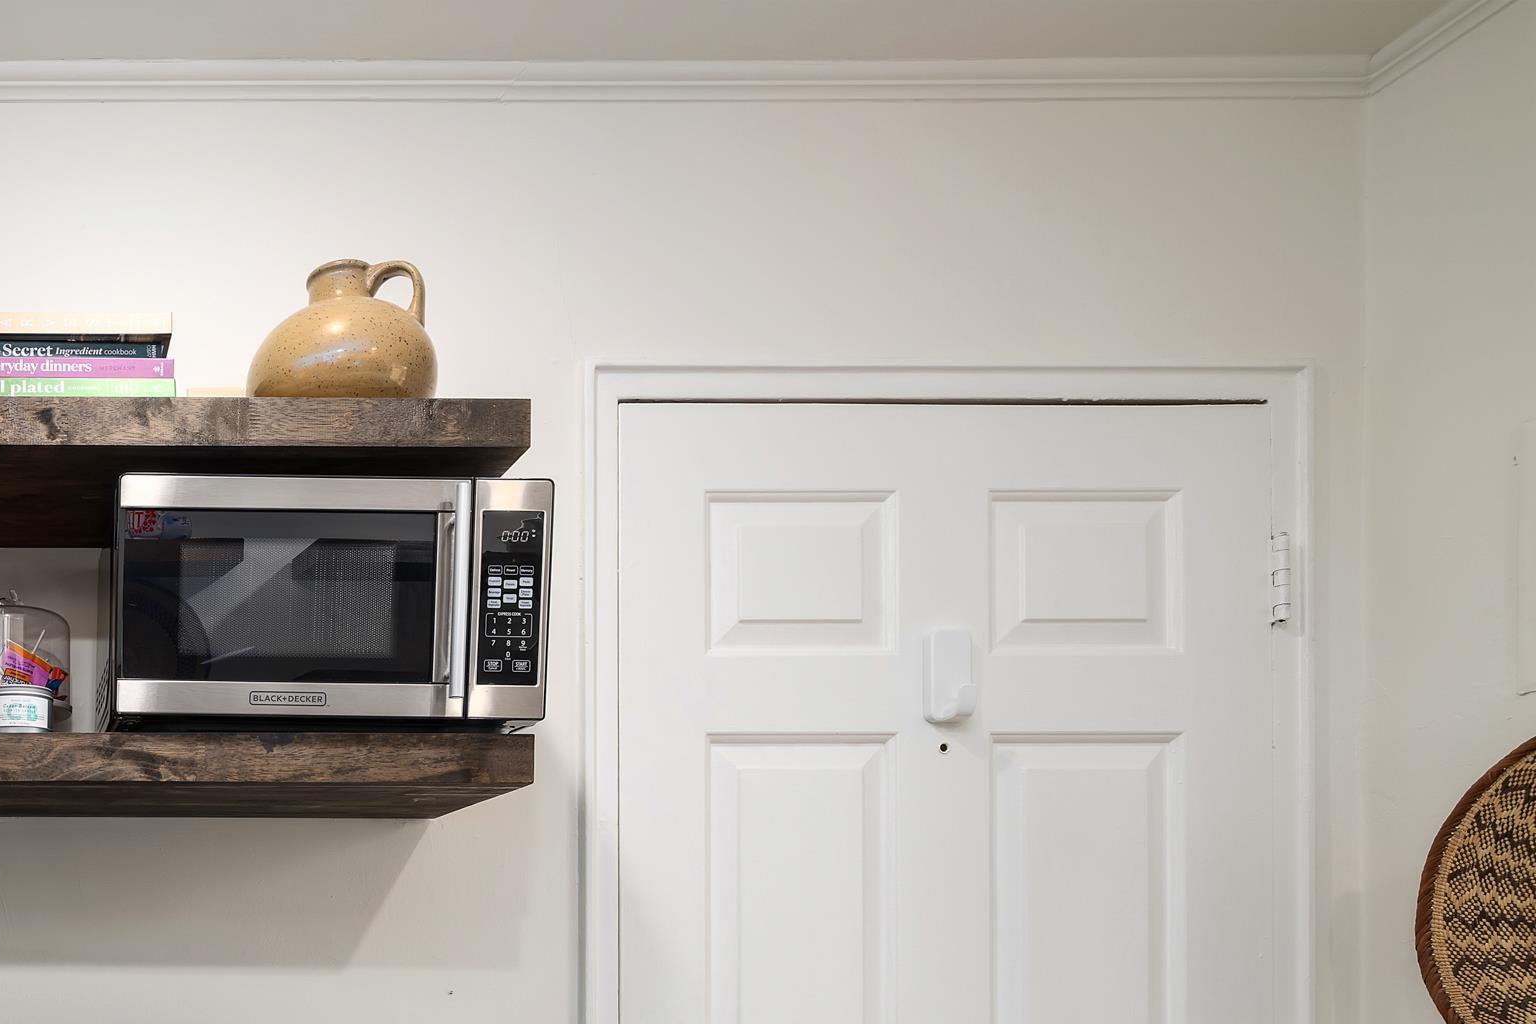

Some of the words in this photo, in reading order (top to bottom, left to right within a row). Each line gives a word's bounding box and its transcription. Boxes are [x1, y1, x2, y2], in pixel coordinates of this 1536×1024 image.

[2, 343, 53, 357] Secret
[55, 347, 103, 357] Ingredient
[40, 359, 92, 372] dinners
[10, 380, 64, 397] plated
[253, 694, 323, 703] BLACK+DECKER
